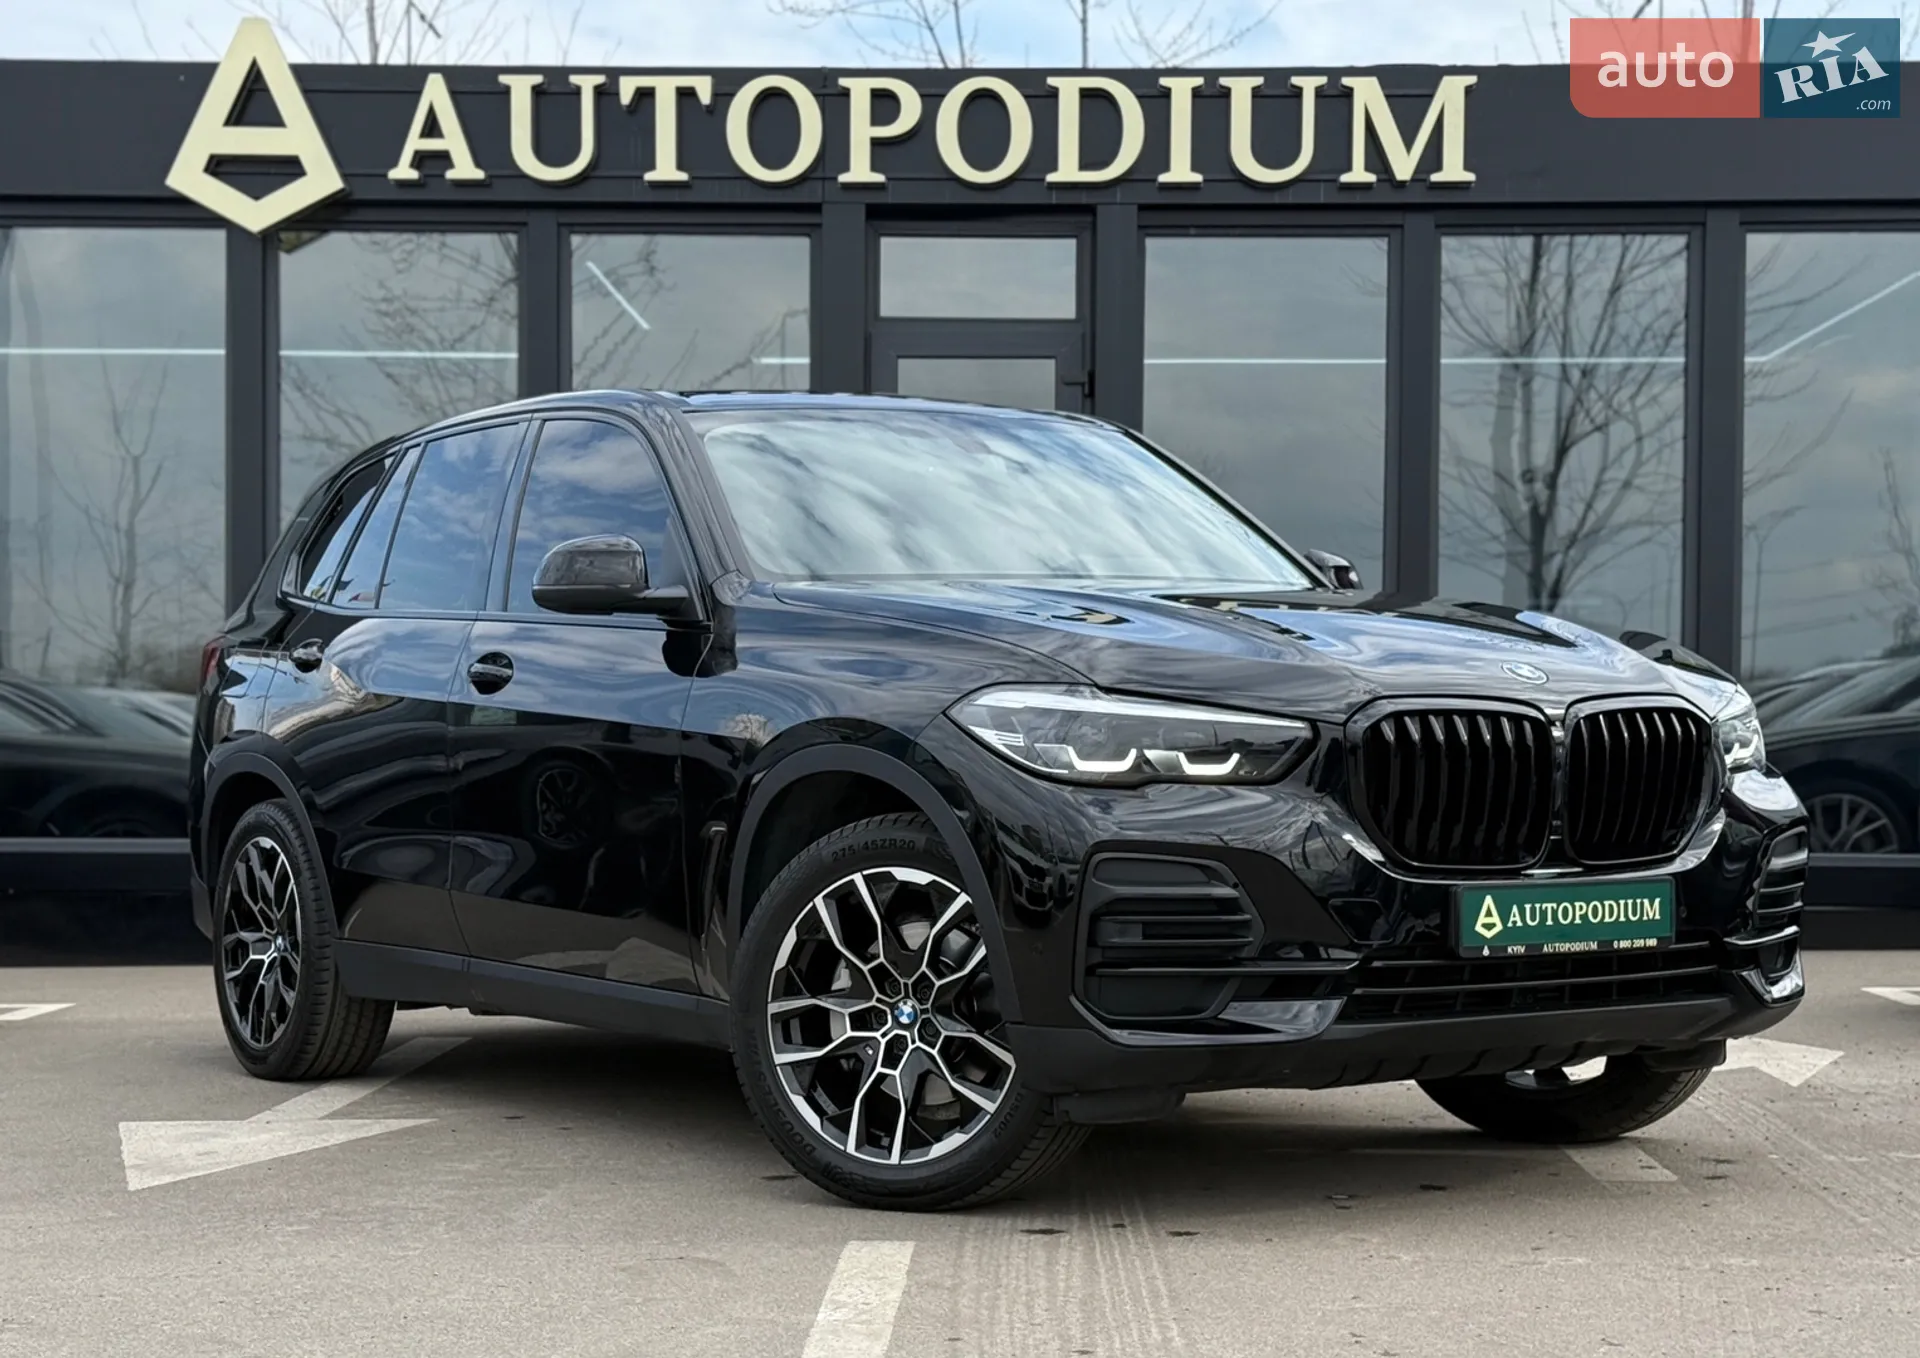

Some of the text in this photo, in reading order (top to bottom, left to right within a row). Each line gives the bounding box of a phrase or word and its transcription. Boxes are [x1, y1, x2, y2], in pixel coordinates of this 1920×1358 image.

[387, 73, 1478, 184] AUTOPODIUM
[1507, 898, 1661, 928] AUTOPODIUM
[1507, 945, 1526, 955] KYIV
[1542, 941, 1598, 953] AUTOPODIUM
[1613, 940, 1618, 949] 0
[1619, 939, 1632, 949] 800
